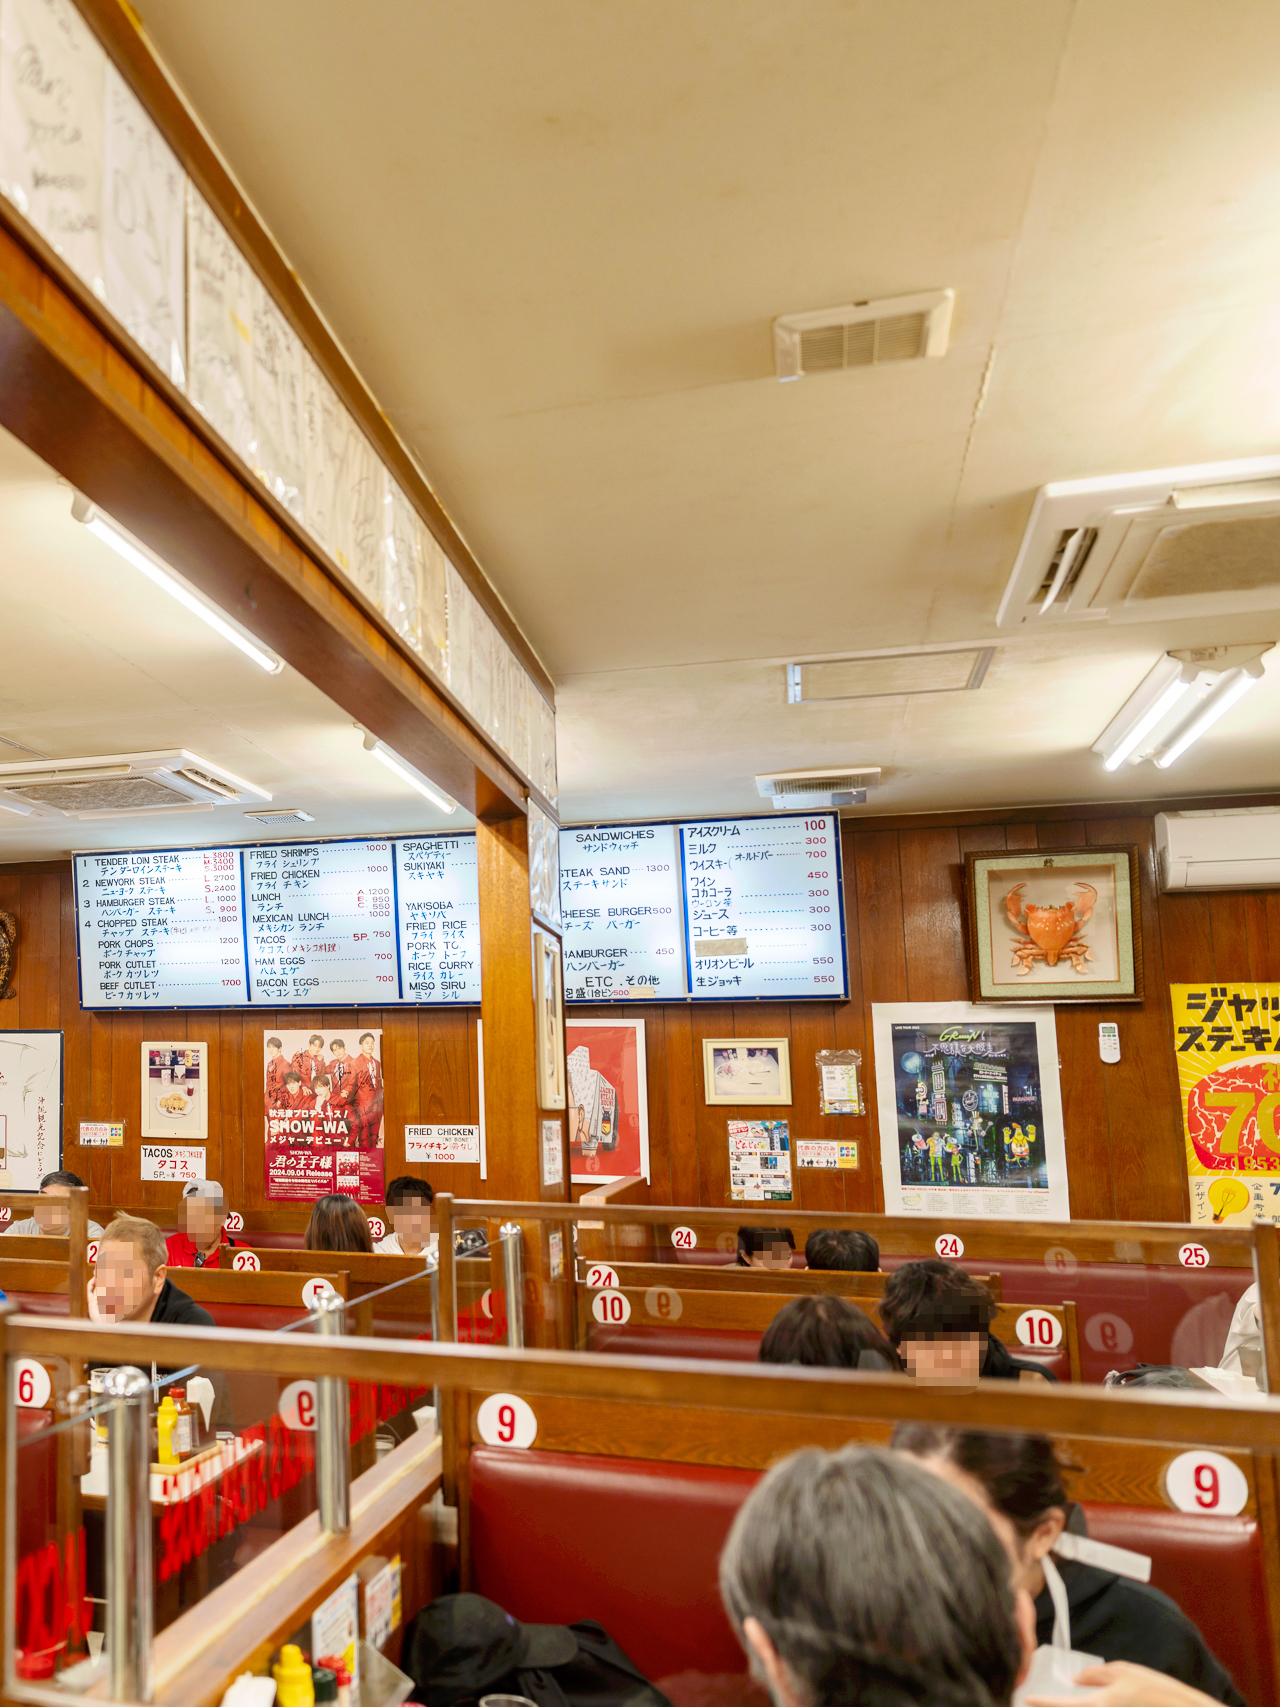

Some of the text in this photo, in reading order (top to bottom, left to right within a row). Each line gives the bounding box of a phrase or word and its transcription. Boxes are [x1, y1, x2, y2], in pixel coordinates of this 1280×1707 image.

[688, 820, 826, 838] アイスクリーム 100
[576, 830, 654, 842] SANDWICHES
[403, 841, 459, 851] SPAGHETTI
[689, 844, 716, 854] ミルク
[250, 851, 277, 859] FRIED
[281, 848, 319, 857] SHRIMPS
[83, 859, 87, 867] 1
[95, 858, 128, 866] TENDER
[153, 855, 179, 864] STEAK
[404, 862, 445, 871] SUKIYAKI
[600, 864, 670, 876] SAND 1300
[251, 872, 277, 880] FRIED
[282, 870, 320, 879] CHICKEN
[691, 871, 828, 887] ワイン 450
[95, 878, 135, 887] NEWYORK
[139, 877, 165, 885] STEAK
[140, 886, 165, 894] ステーキ
[692, 888, 829, 897] コカコーラ 300
[252, 893, 280, 901] LUNCH
[84, 900, 90, 908] 3
[96, 898, 144, 907] HAMBURGER
[149, 897, 175, 905] STEAK
[257, 903, 283, 911] ランチ
[406, 901, 453, 910] YAKISOBA
[148, 906, 176, 915] ステーキ
[608, 907, 651, 916] BURGER
[693, 909, 729, 920] ジュース
[142, 918, 167, 926] STEAK
[253, 914, 293, 923] MEXICAN
[298, 913, 329, 921] LUNCH
[300, 923, 324, 931] ランチ
[406, 921, 467, 930] FRIED RICE
[125, 940, 153, 948] CHOPS
[254, 936, 286, 944] TACOS
[407, 942, 436, 950] PORK
[99, 961, 121, 969] PORK
[126, 960, 156, 968] CUTLET
[280, 957, 305, 965] EGGS
[408, 961, 474, 970] RICE CURRY
[695, 958, 754, 970] オリオンビール
[100, 982, 119, 990] BEEF
[257, 979, 287, 987] BACON
[293, 978, 319, 986] EGGS
[409, 981, 465, 990] MISO SIRU
[585, 976, 613, 987] ETC
[696, 976, 742, 986] 生ジョッキ
[269, 1120, 348, 1134] SHOW-WA
[408, 1128, 474, 1136] FRIED CHICKEN
[142, 1148, 172, 1158] TACOS
[157, 1160, 188, 1170] タコス
[269, 1155, 332, 1169] 君の王子様
[227, 1216, 241, 1230] 22
[676, 1231, 691, 1247] 24
[939, 1238, 959, 1257] 24
[1183, 1247, 1205, 1265] 25
[237, 1256, 255, 1271] 23
[600, 1296, 623, 1321] 10
[1026, 1317, 1053, 1344] 10
[19, 1368, 34, 1403] 6
[498, 1405, 515, 1442] 9
[1194, 1463, 1219, 1508] 9
